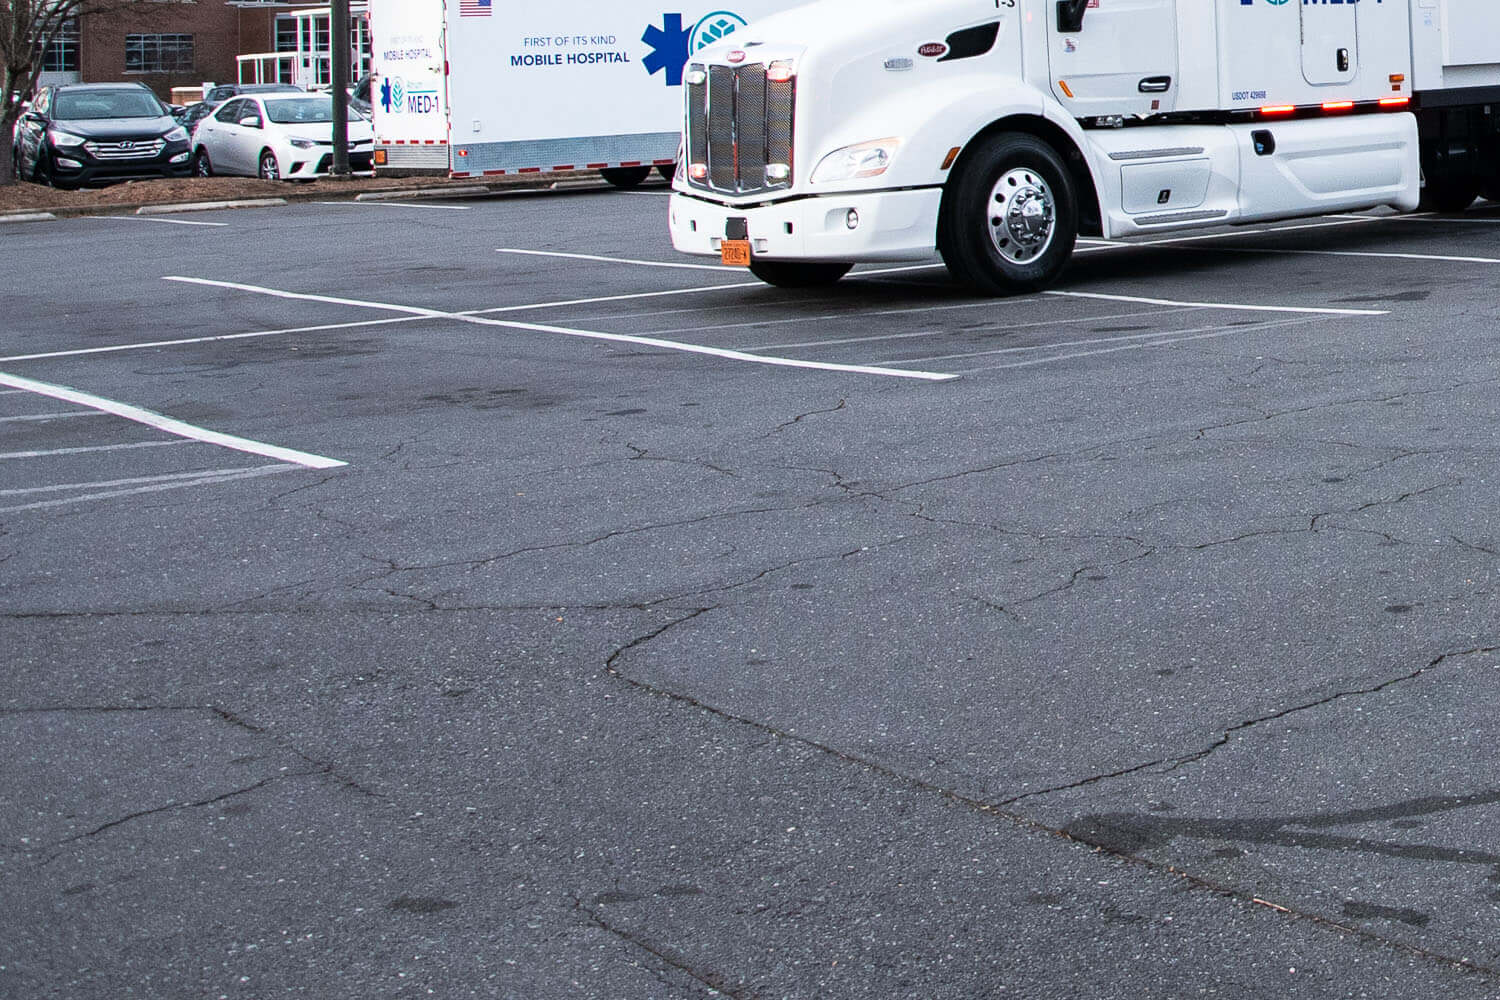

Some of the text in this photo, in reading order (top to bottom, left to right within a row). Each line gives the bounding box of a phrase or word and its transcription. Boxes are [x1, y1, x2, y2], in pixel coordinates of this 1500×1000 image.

[523, 35, 616, 47] FIRST OF ITS KIND
[510, 52, 630, 66] MOBILE HOSPITAL
[407, 95, 439, 113] MED-1
